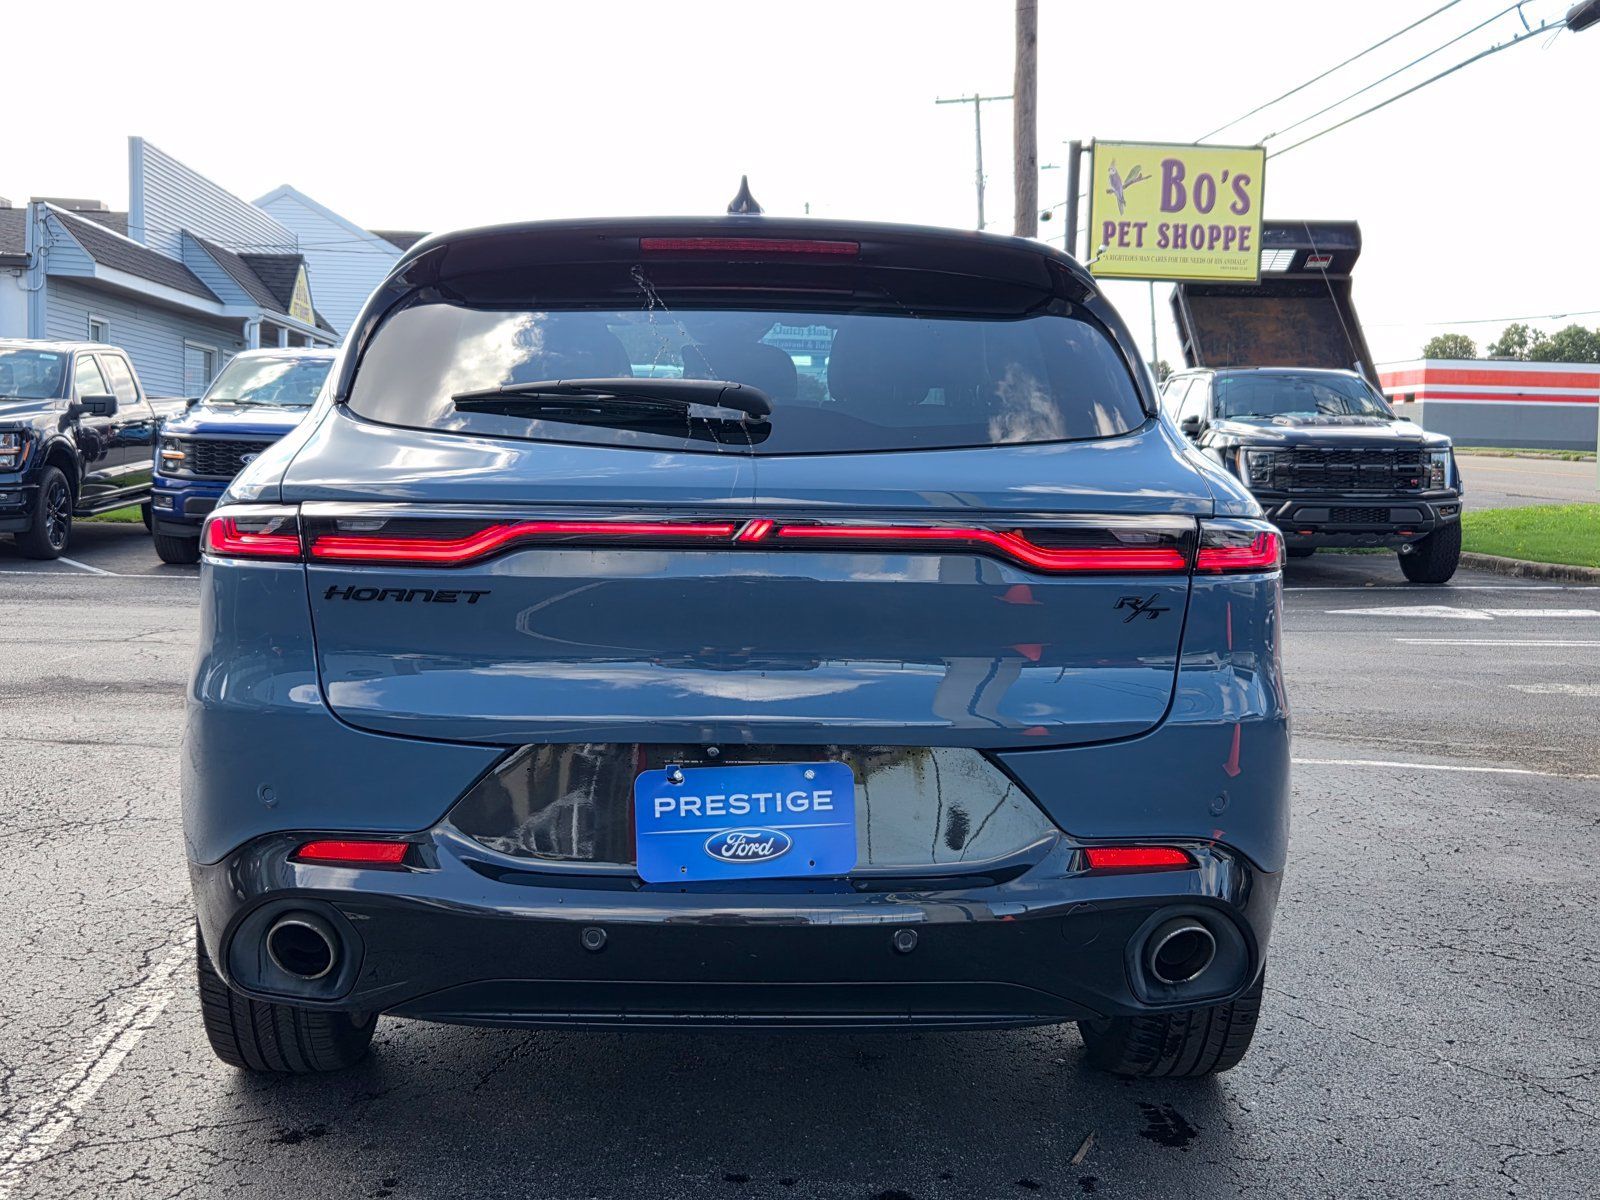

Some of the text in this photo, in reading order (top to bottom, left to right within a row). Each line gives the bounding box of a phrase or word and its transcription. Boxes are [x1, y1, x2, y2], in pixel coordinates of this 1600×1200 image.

[1102, 220, 1252, 252] PET SHOPPE
[323, 584, 492, 604] HORNET
[1113, 592, 1171, 623] R/T
[653, 790, 834, 819] PRESTIGE
[721, 831, 775, 858] Ford
